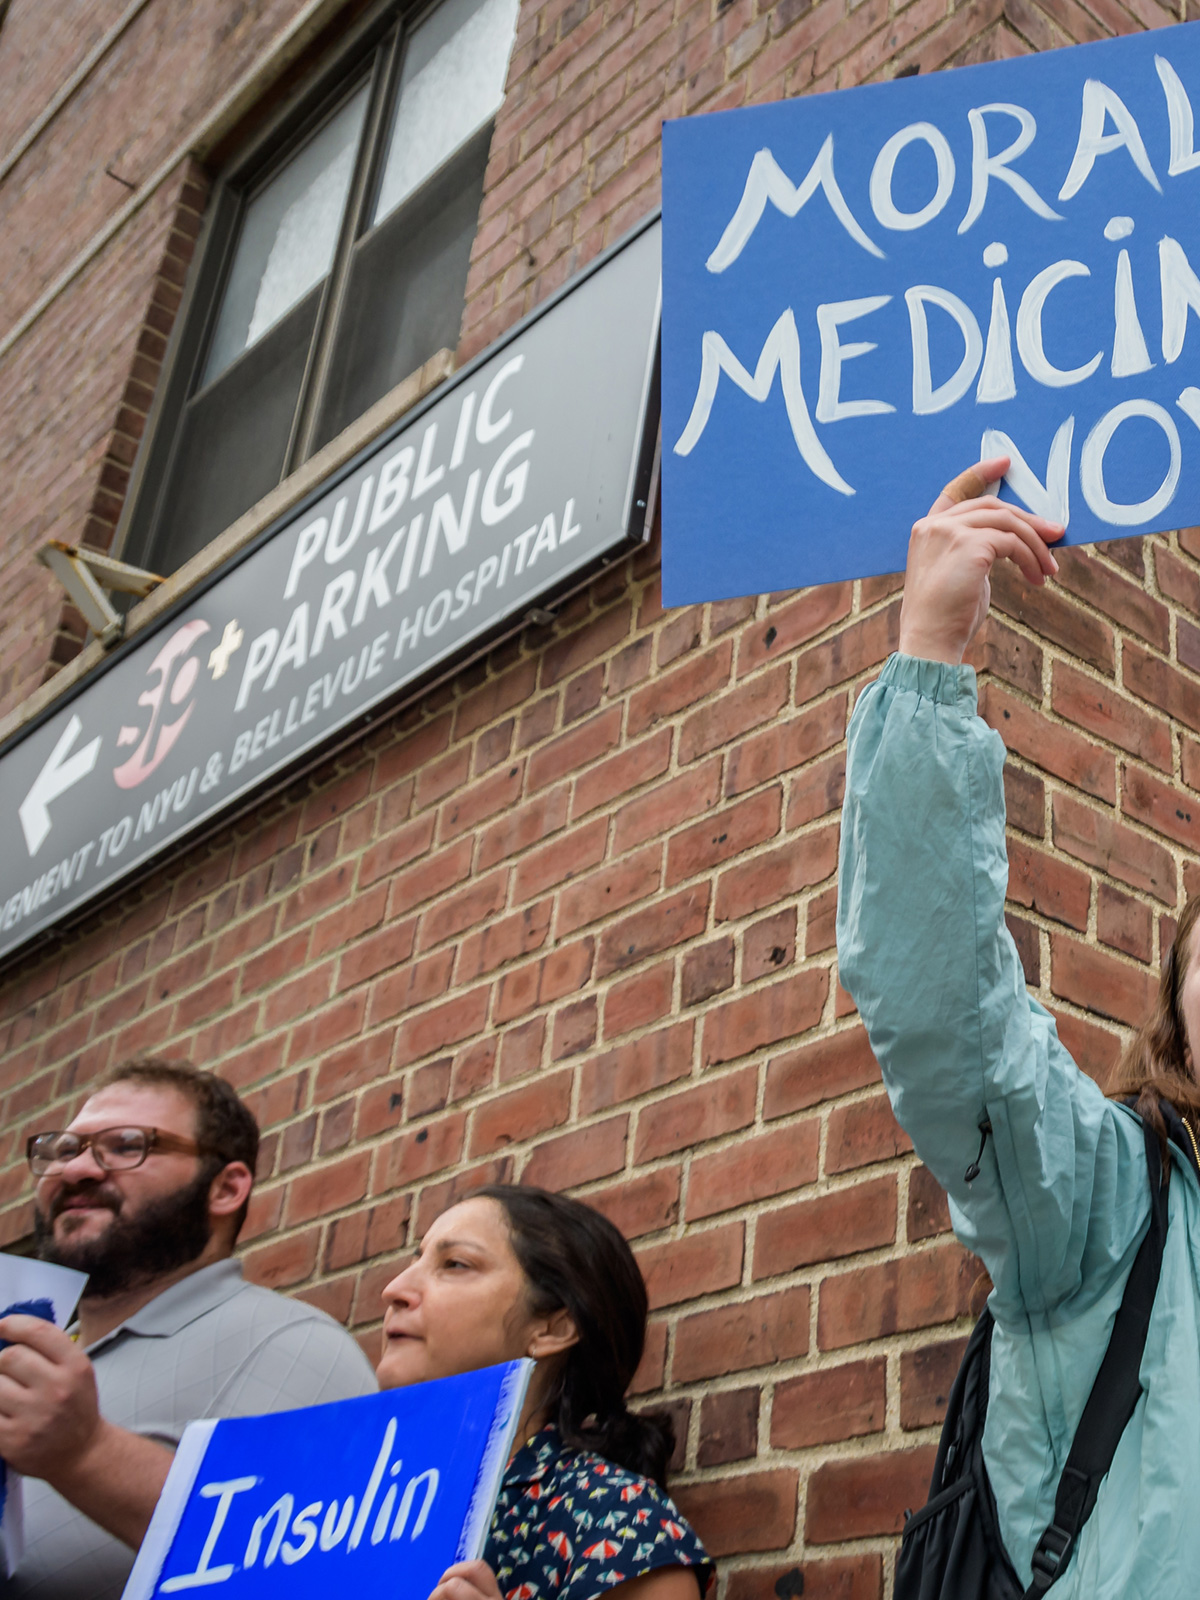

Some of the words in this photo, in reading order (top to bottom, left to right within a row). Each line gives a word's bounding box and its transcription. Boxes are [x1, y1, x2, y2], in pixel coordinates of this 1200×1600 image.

[234, 428, 536, 713] PARKING
[283, 353, 526, 601] PUBLIC
[96, 815, 133, 867] TO
[133, 766, 199, 842] NYU
[199, 751, 223, 794] &
[228, 629, 391, 776] BELLEVUE
[393, 497, 582, 661] HOSPITAL
[159, 1416, 440, 1594] Insulin
